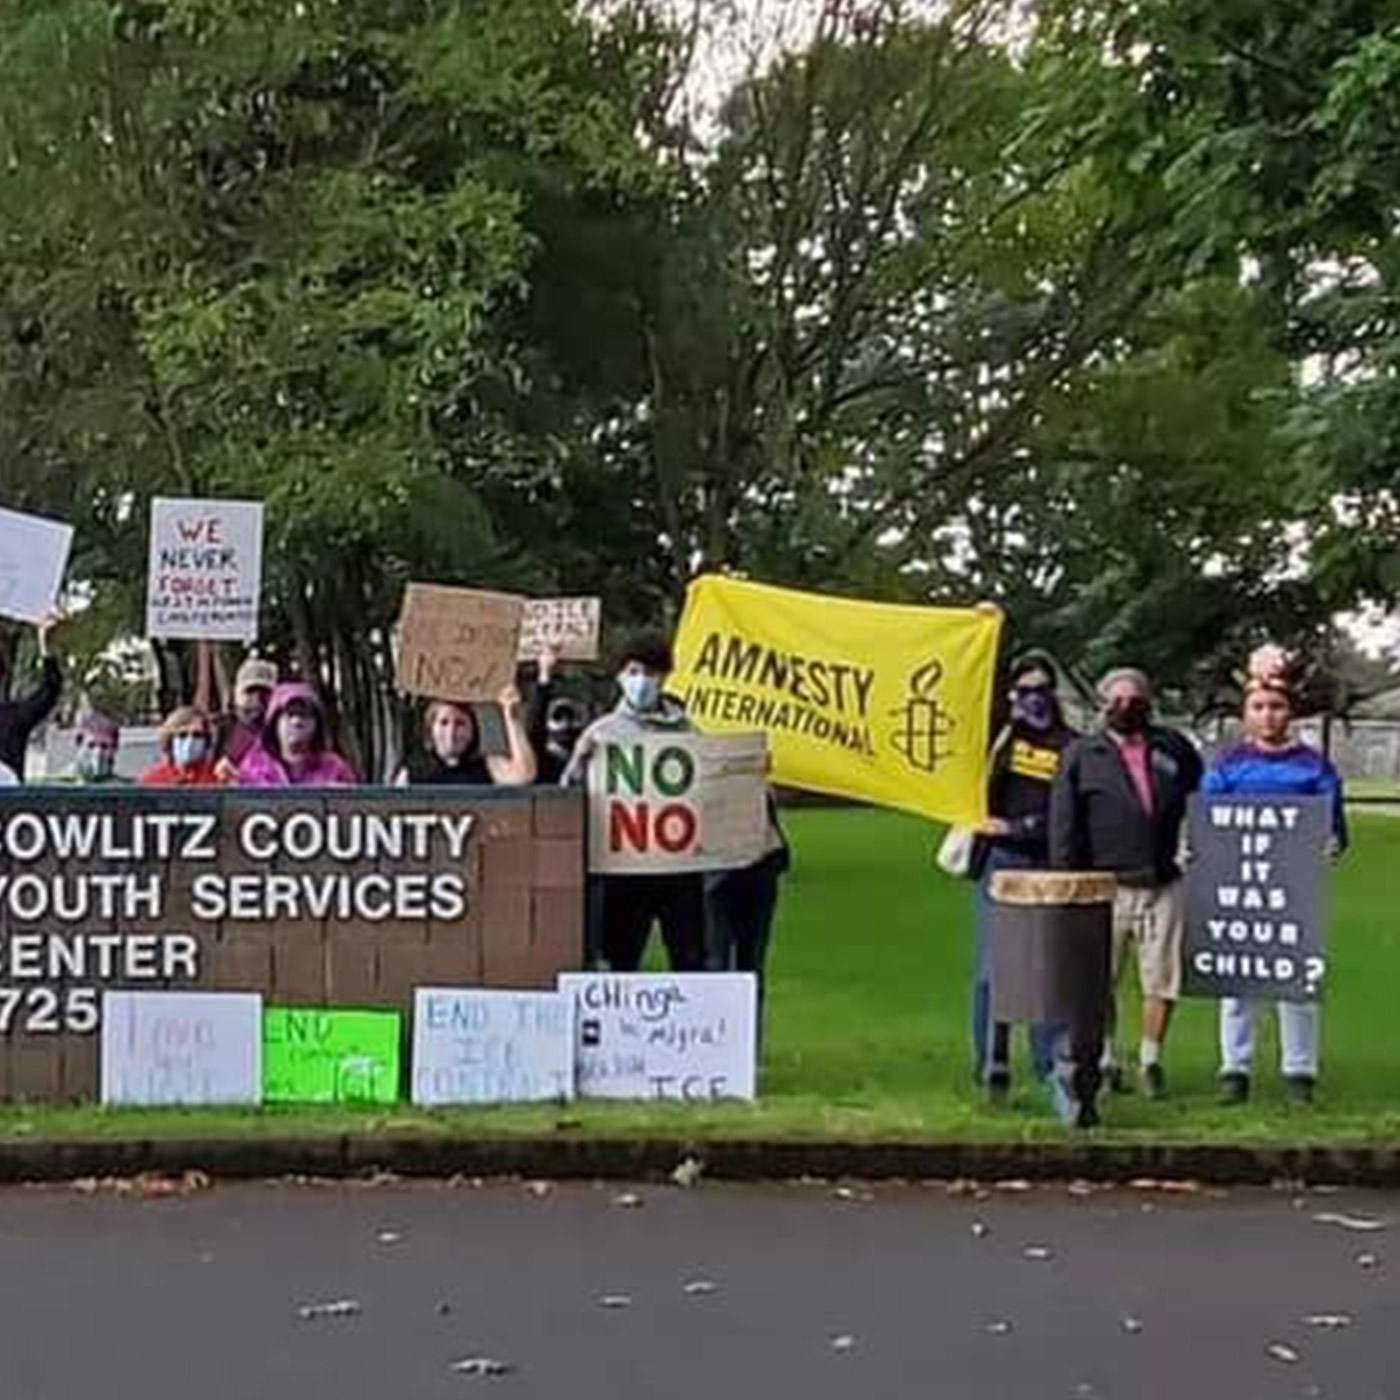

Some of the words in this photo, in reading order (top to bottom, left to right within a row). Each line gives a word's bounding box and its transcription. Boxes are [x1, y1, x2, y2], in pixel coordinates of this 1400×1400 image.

[177, 518, 222, 544] WE
[159, 547, 238, 573] NEVER
[694, 633, 875, 717] AMNESTY
[684, 686, 875, 757] INTERNATIONAL
[605, 743, 695, 796] NO
[1212, 805, 1300, 831] WHAT
[242, 814, 474, 860] COUNTY
[1241, 835, 1271, 857] IF
[1241, 863, 1270, 885] IT
[191, 874, 466, 920] SERVICES
[1217, 888, 1287, 910] WAS
[1209, 920, 1300, 944] YOUR
[425, 996, 490, 1029] END
